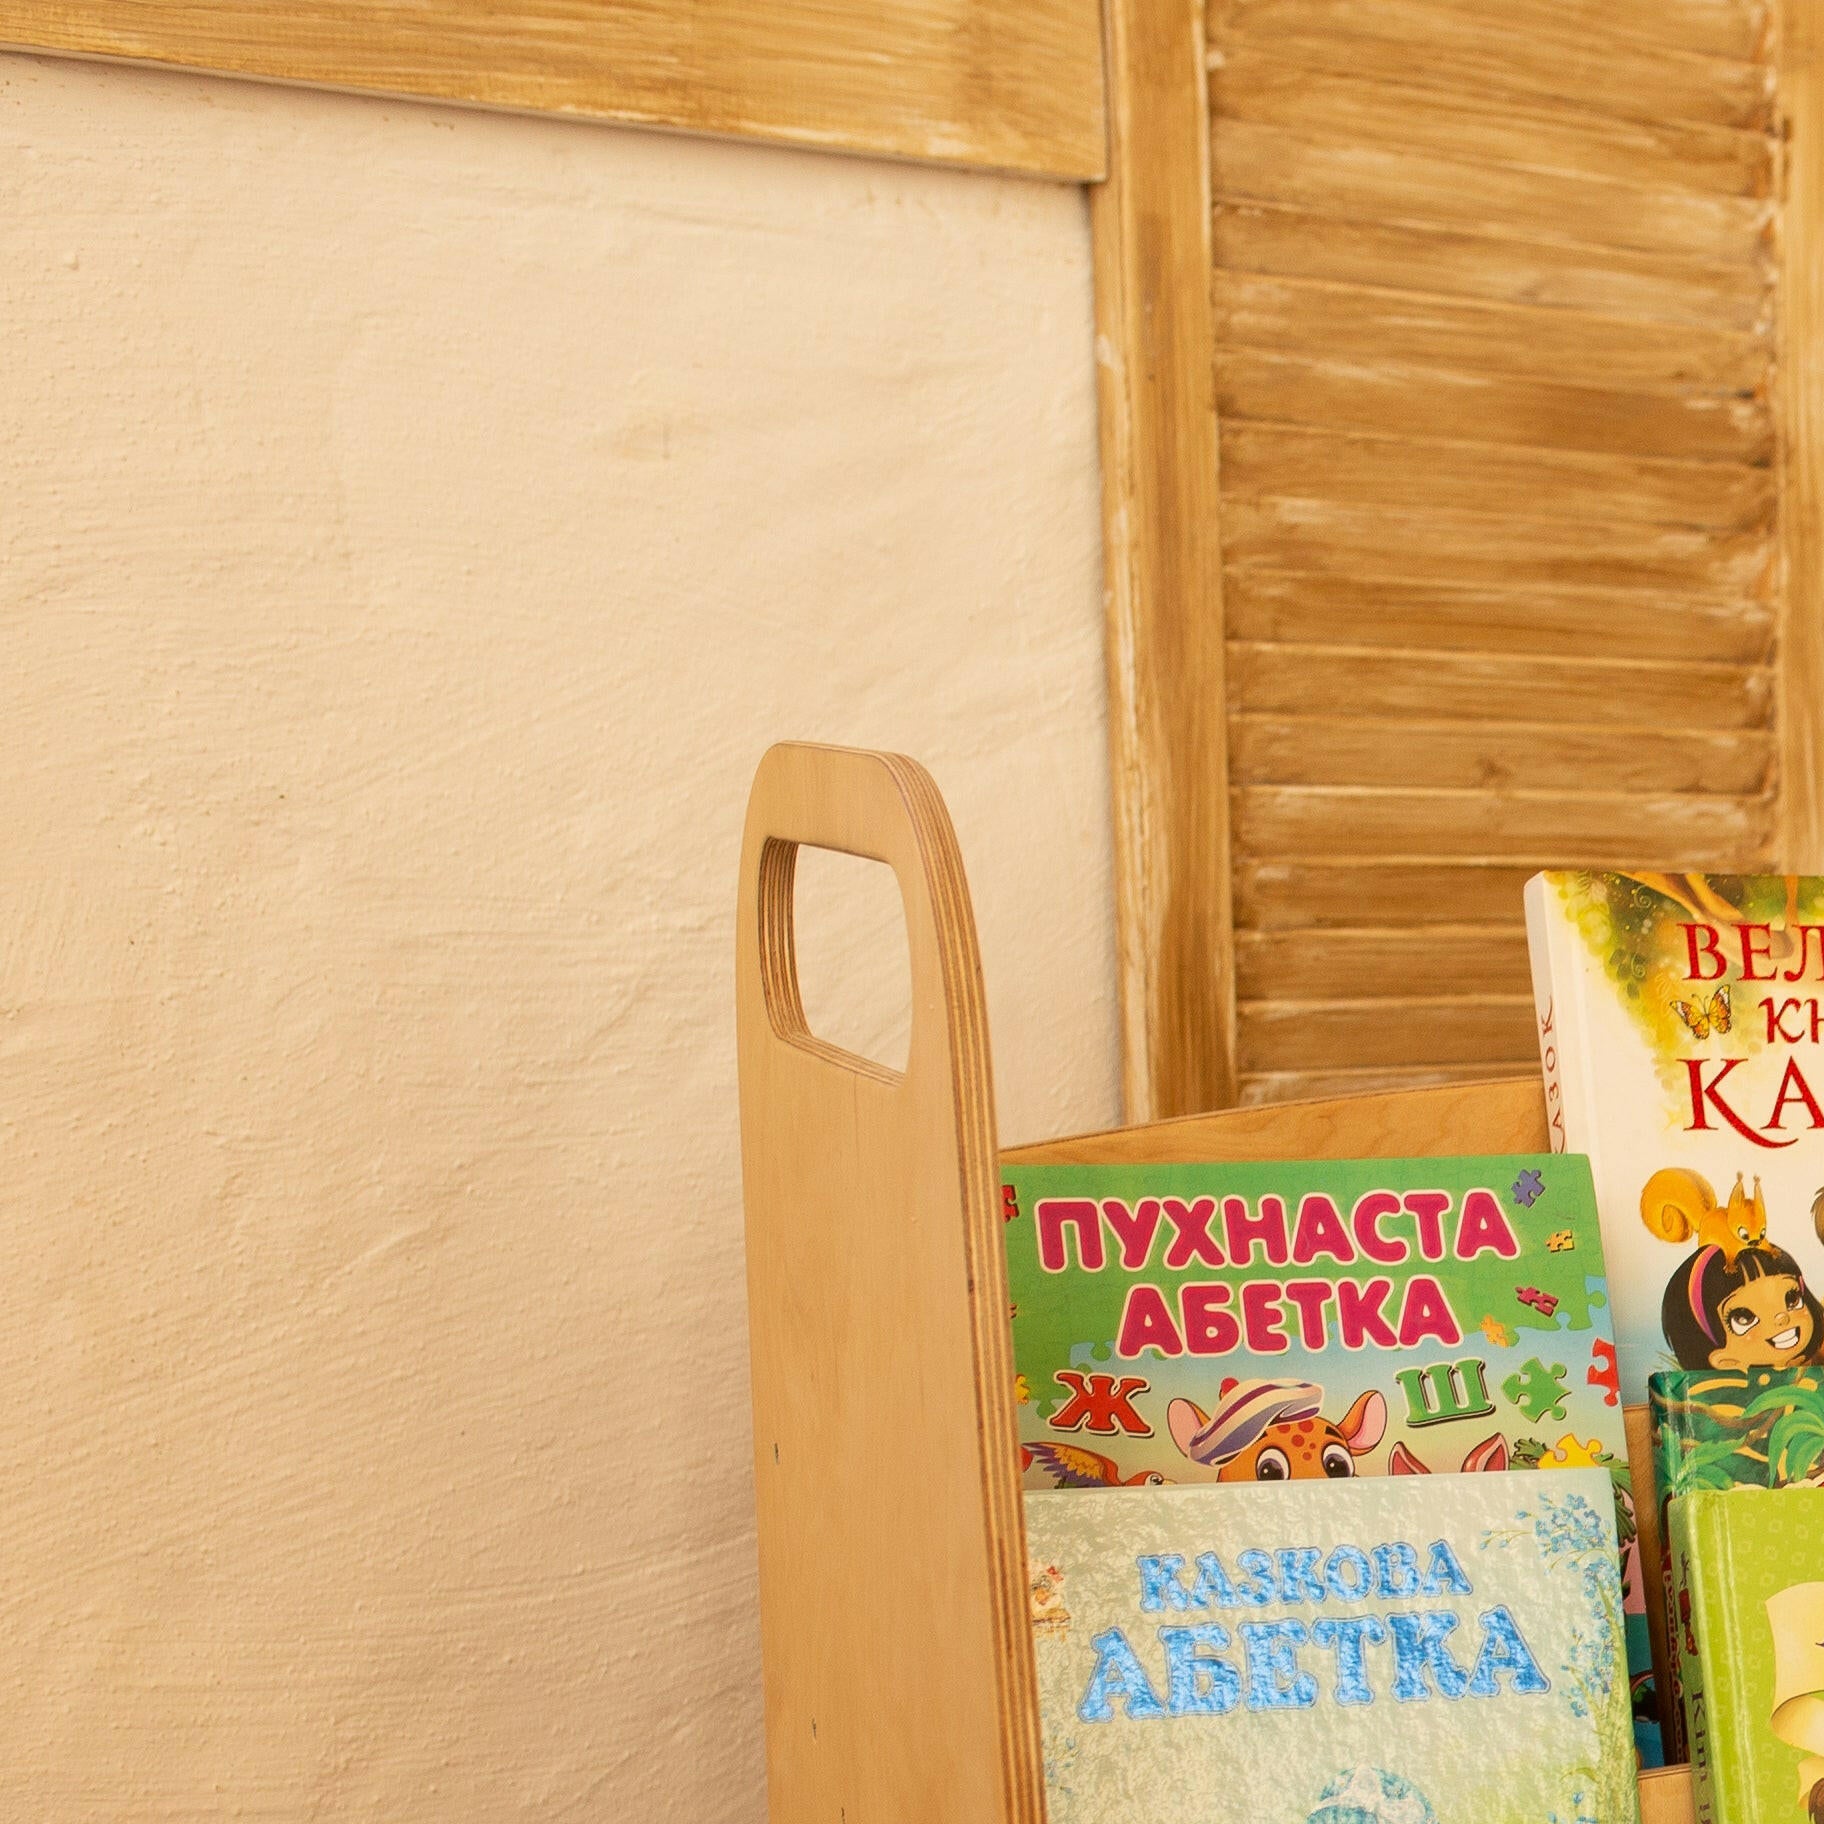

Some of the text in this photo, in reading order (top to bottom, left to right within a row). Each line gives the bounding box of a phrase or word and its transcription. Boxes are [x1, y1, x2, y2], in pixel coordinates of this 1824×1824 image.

[1035, 1188, 1520, 1272] ПУХНАСТА
[1116, 1275, 1466, 1359] АБЕТКА
[1048, 1369, 1155, 1437] Ж
[1394, 1358, 1496, 1427] Ш
[1136, 1538, 1473, 1613] КАЗКОВА
[1077, 1604, 1551, 1724] АБЕТКА
